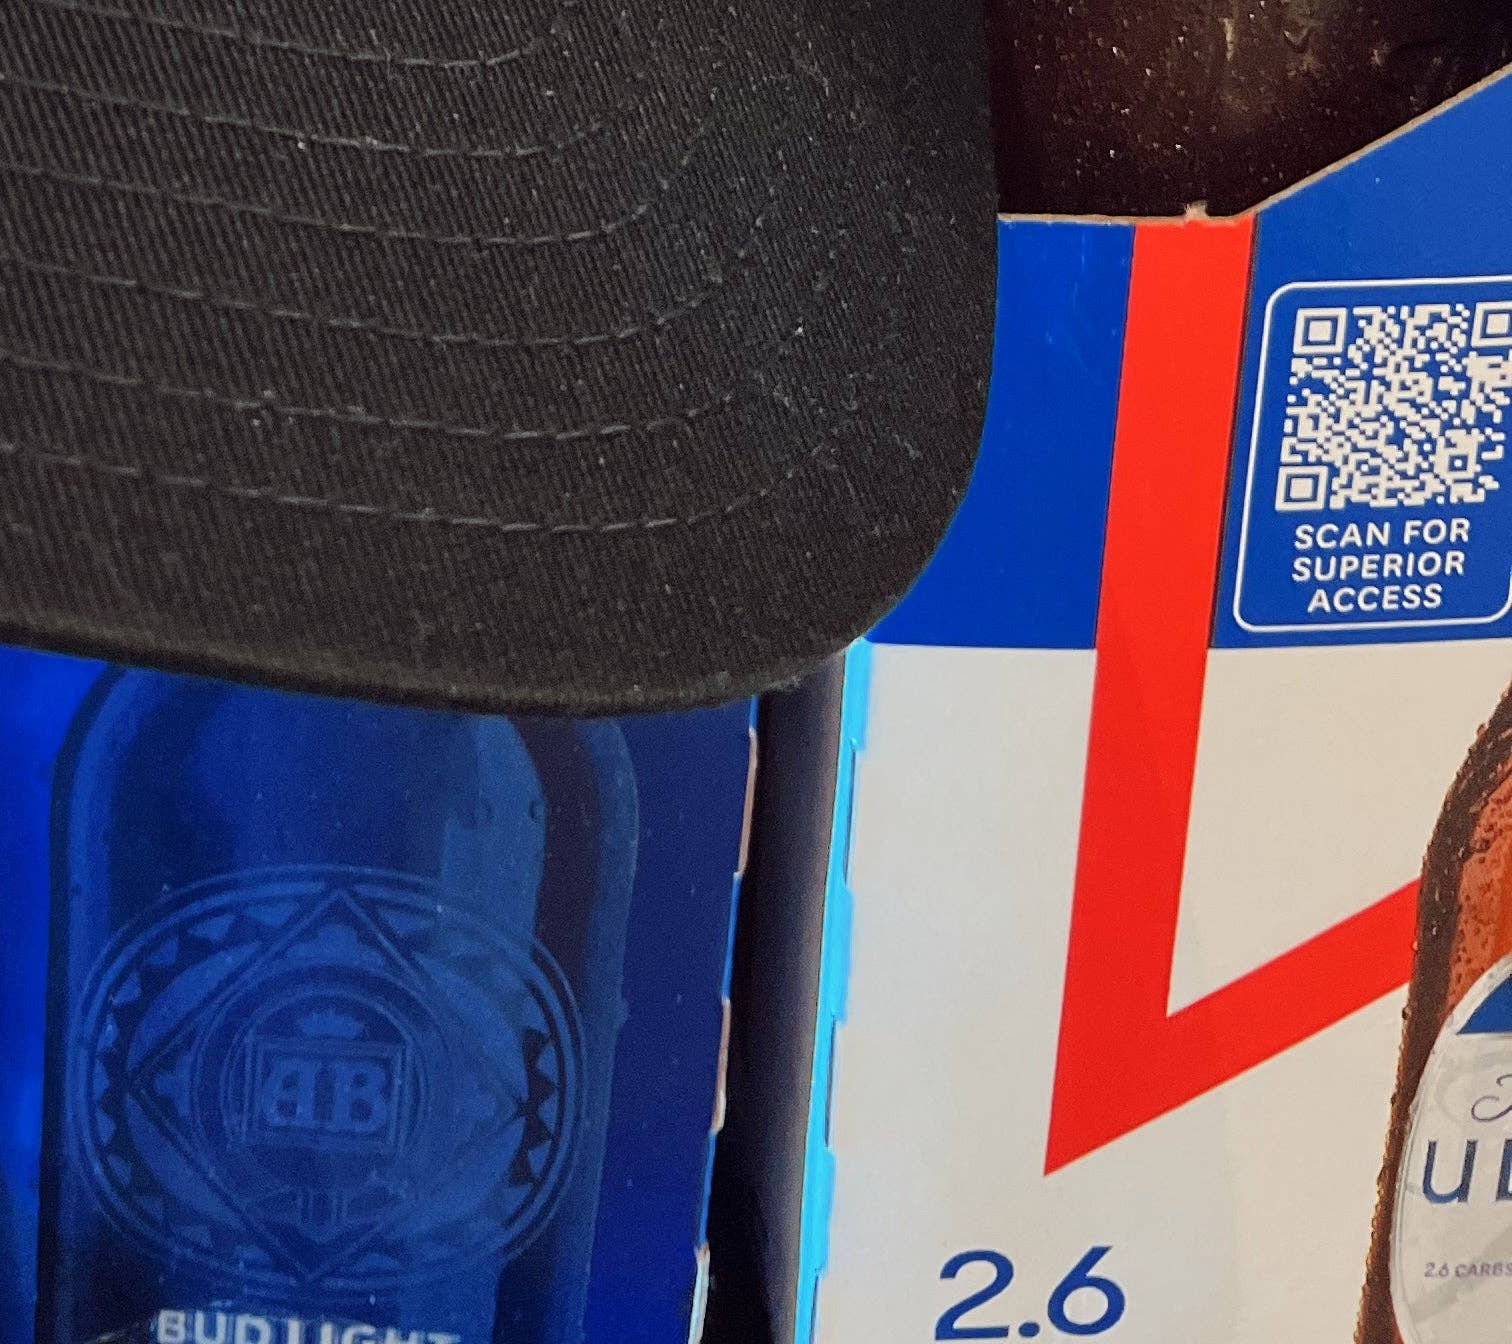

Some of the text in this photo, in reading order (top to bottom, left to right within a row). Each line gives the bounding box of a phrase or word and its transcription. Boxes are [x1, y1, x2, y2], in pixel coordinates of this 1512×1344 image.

[1294, 518, 1469, 550] SCAN FOR
[1291, 551, 1465, 582] SUPERIOR
[1307, 583, 1443, 613] ACCESS
[934, 1245, 1126, 1341] 2.6
